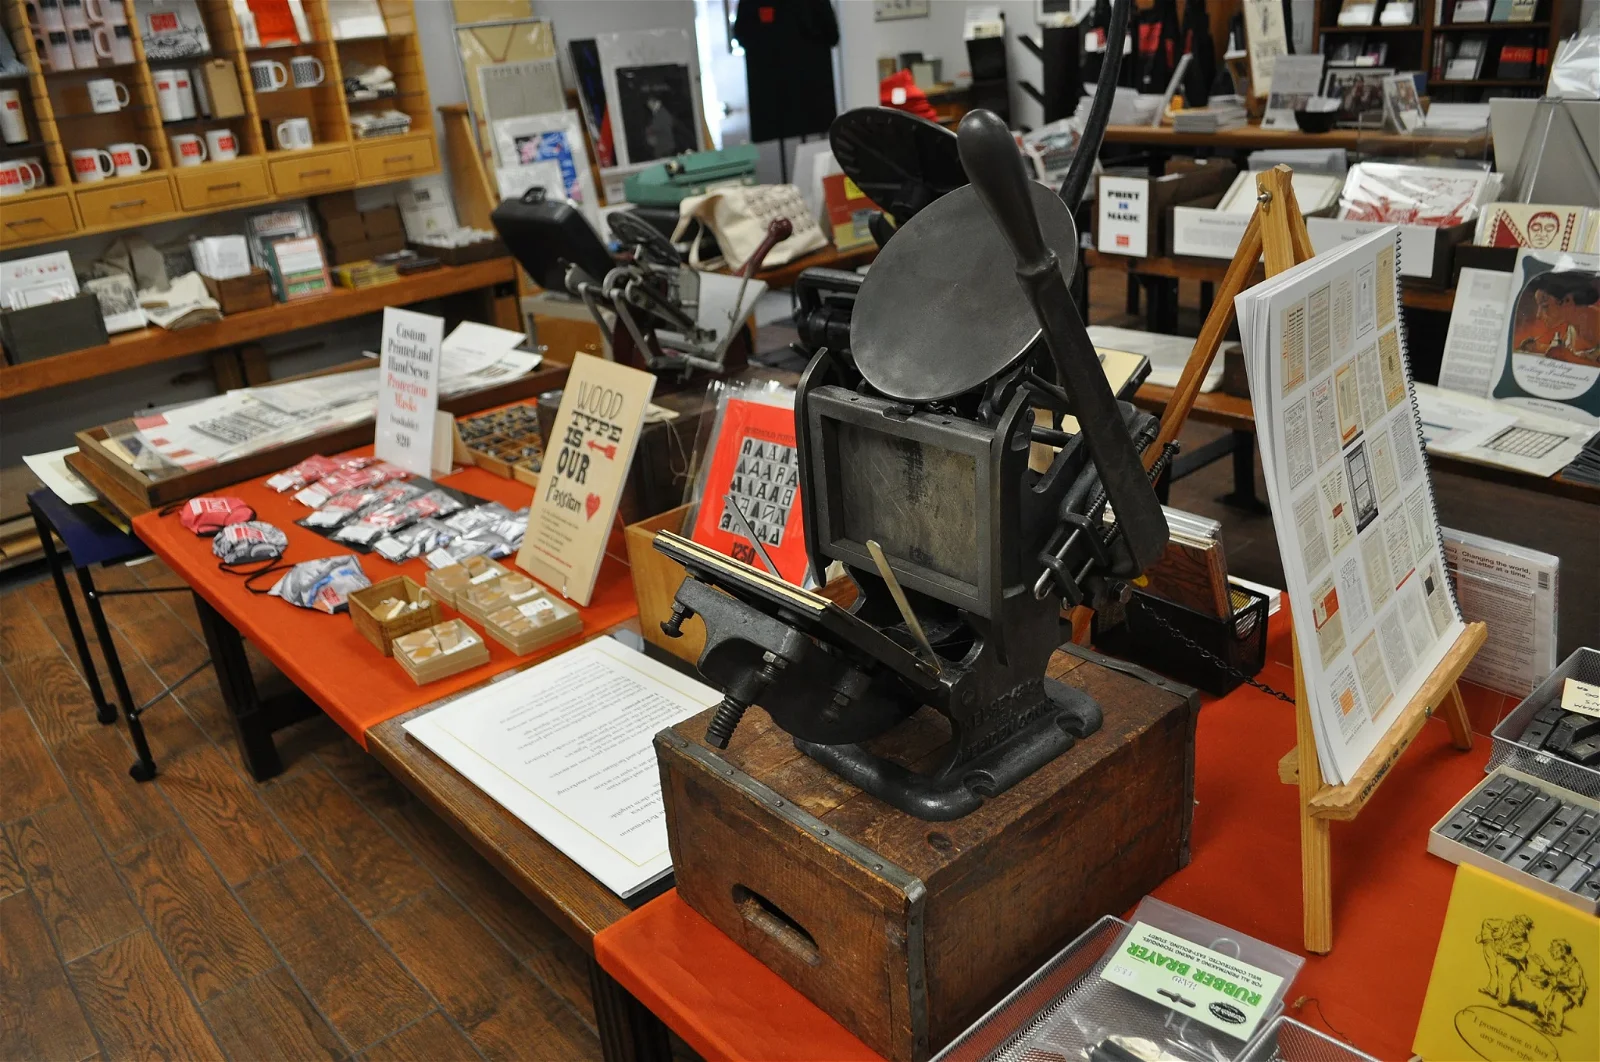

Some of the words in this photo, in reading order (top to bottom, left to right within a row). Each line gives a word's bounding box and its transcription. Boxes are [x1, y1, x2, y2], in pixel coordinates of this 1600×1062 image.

[1108, 190, 1140, 200] PRINT
[1108, 212, 1140, 222] MAGIC
[396, 322, 427, 343] Custom
[388, 339, 418, 360] Printed
[418, 346, 433, 363] and
[388, 356, 409, 375] Hand
[410, 361, 430, 380] Sewn
[387, 373, 428, 397] Protection
[394, 391, 418, 412] Masks
[577, 380, 625, 420] WOOD
[564, 427, 583, 448] IS
[571, 411, 623, 443] TYPE
[396, 433, 411, 450] $20
[556, 446, 590, 484] OUR
[546, 475, 582, 512] Passion
[1462, 551, 1494, 566] Changing
[1496, 558, 1508, 568] the
[1508, 562, 1532, 574] world,
[1462, 556, 1474, 565] one
[1476, 558, 1494, 570] letter
[629, 799, 657, 815] America
[618, 813, 660, 838] Reformation
[1147, 932, 1168, 943] STURDY
[1126, 942, 1190, 976] BRAYER
[1174, 948, 1195, 960] INKING
[1199, 959, 1240, 978] PRINTMAKING
[1239, 975, 1251, 983] ALL
[1246, 971, 1263, 982] WELL
[1192, 968, 1262, 1007] RUBBER
[1249, 979, 1263, 988] FOR
[1473, 1016, 1478, 1024] I
[1479, 1020, 1508, 1038] promise
[1510, 1034, 1522, 1044] not
[1524, 1042, 1532, 1050] to
[1534, 1044, 1549, 1058] buy
[1480, 1032, 1494, 1044] any
[1496, 1040, 1515, 1053] more
